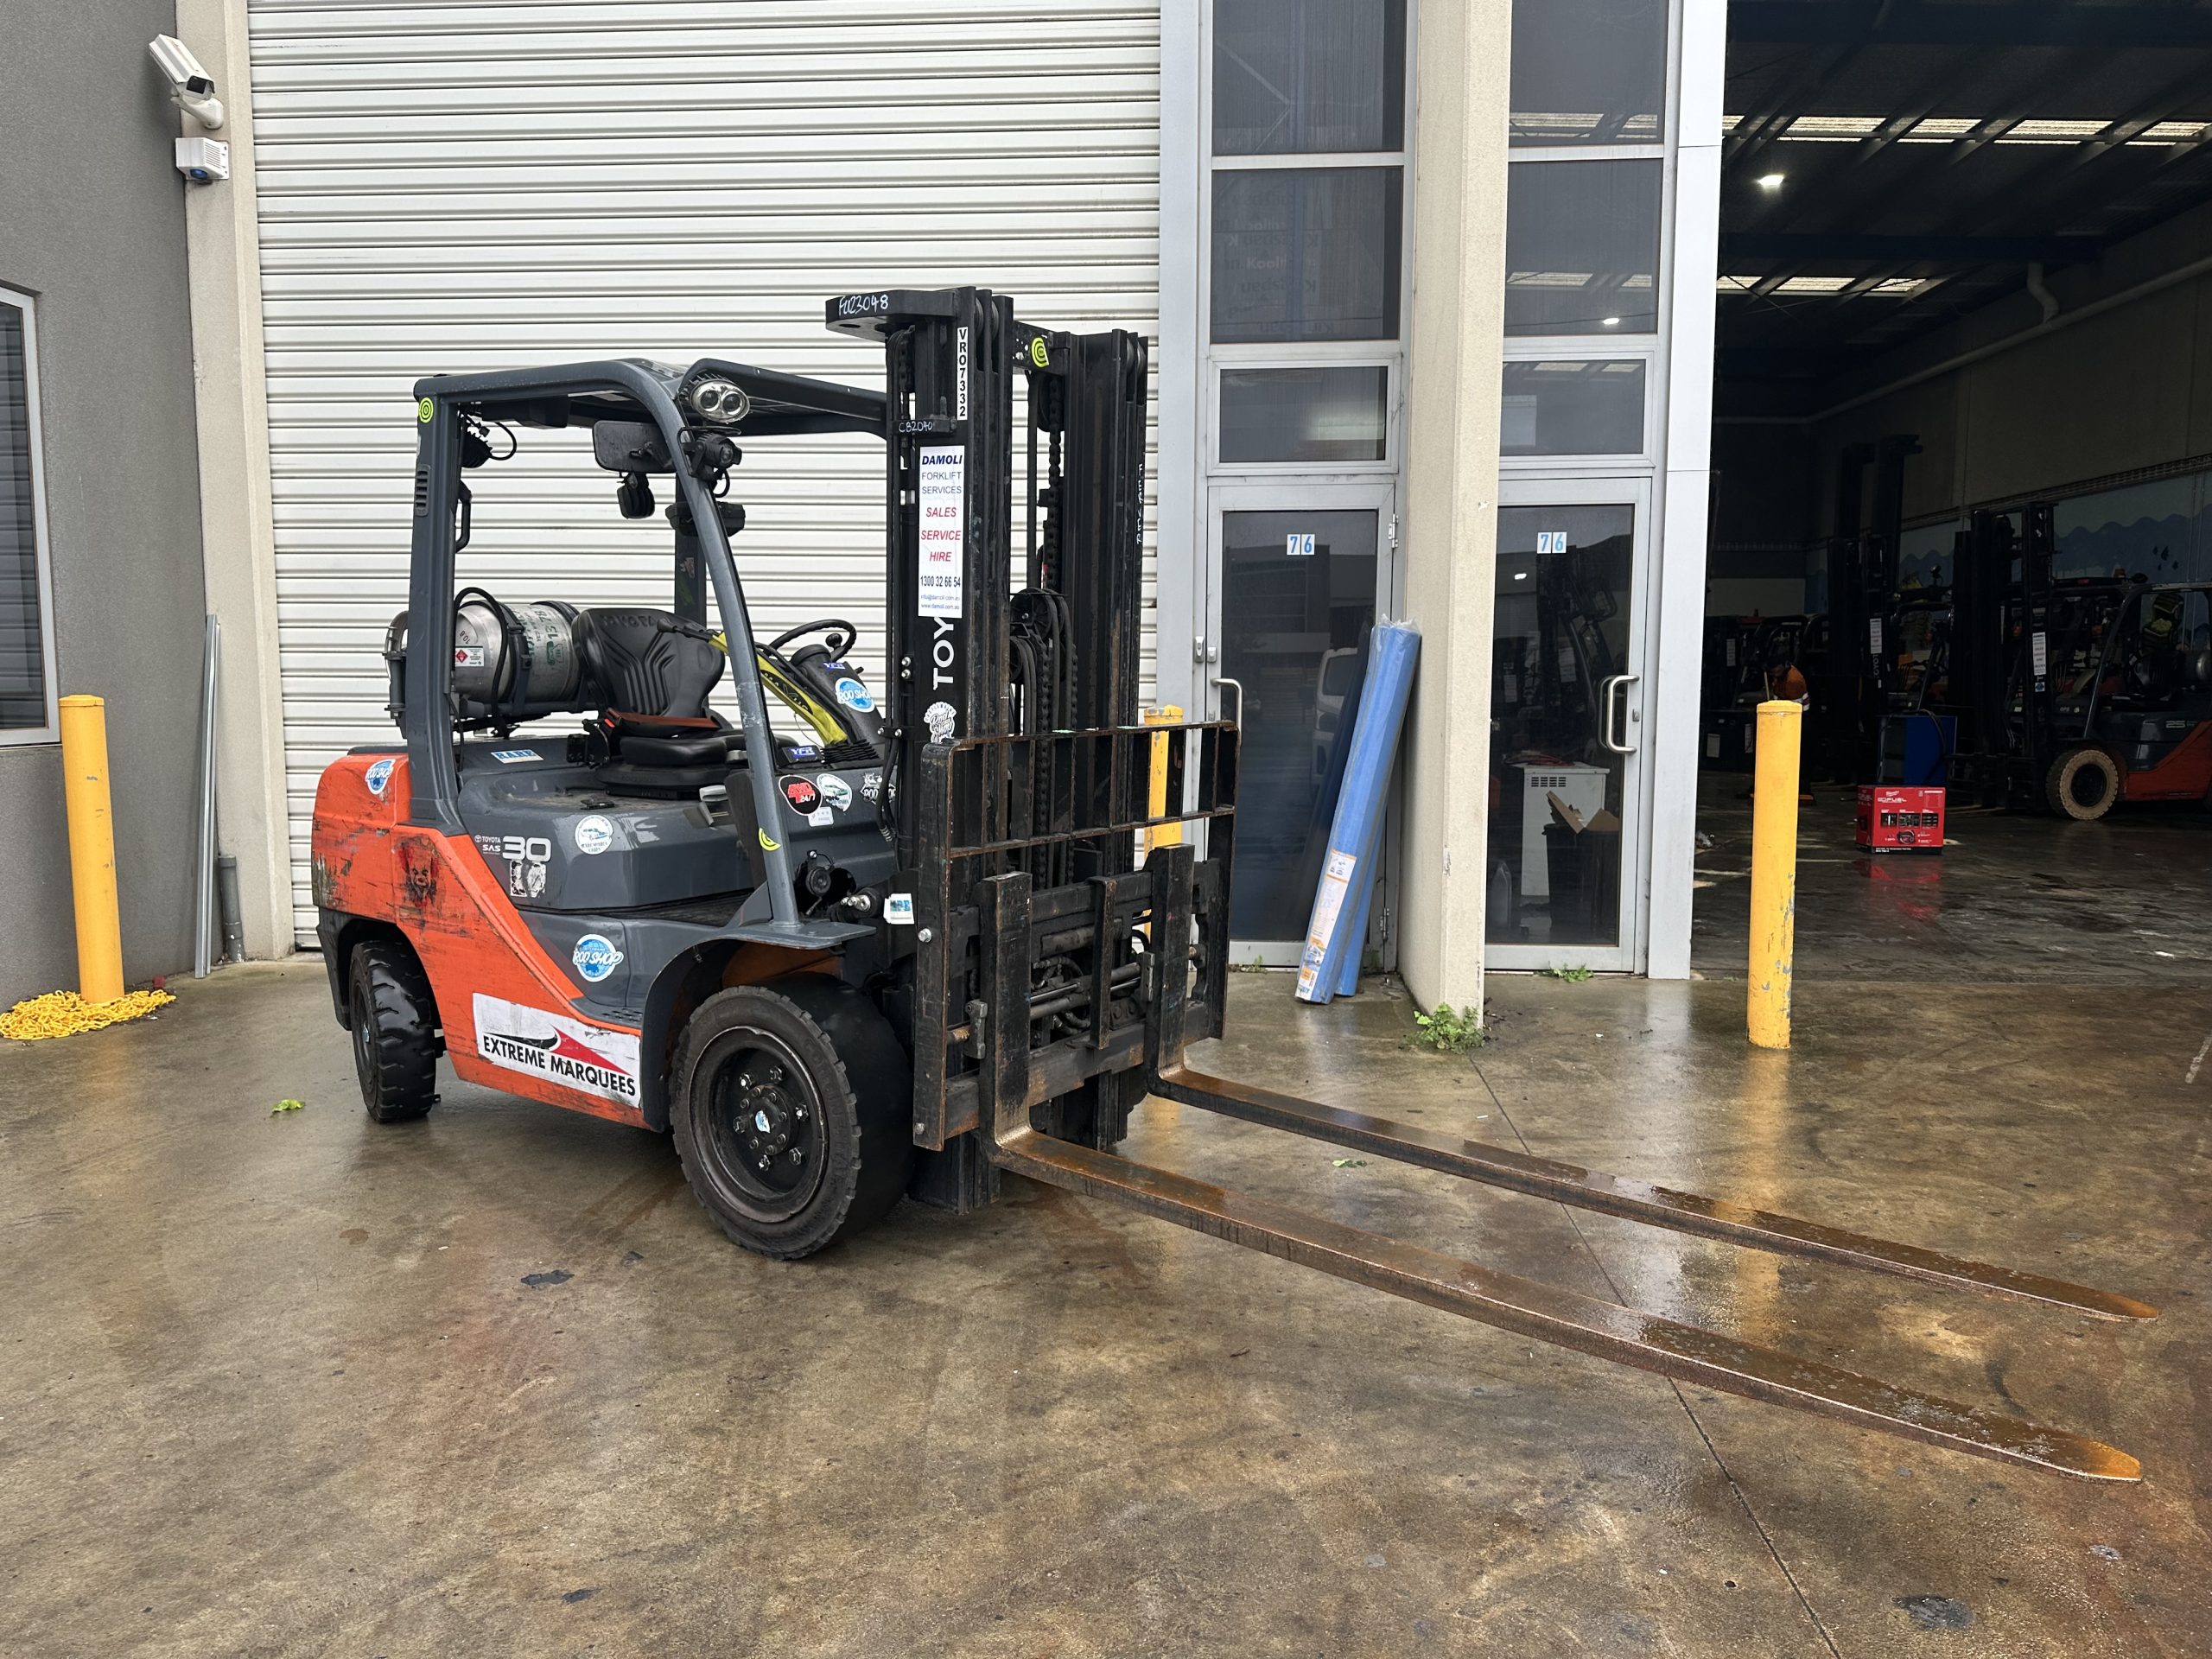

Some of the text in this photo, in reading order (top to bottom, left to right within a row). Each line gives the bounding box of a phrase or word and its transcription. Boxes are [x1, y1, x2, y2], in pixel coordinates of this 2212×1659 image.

[921, 454, 963, 465] DAMOLI
[921, 472, 962, 480] FORKLIFT
[921, 486, 962, 494] SERVICES
[925, 506, 957, 518] SALES
[920, 530, 962, 541] SERVICE
[1290, 535, 1313, 553] 76
[1540, 533, 1564, 552] 76
[929, 551, 952, 563] HIRE
[920, 575, 961, 588] 1300 32 66 54
[481, 836, 501, 844] TOYOTA
[502, 836, 552, 862] 30
[589, 950, 624, 967] SHOP
[482, 1034, 636, 1096] EXTREME MARQUEES
